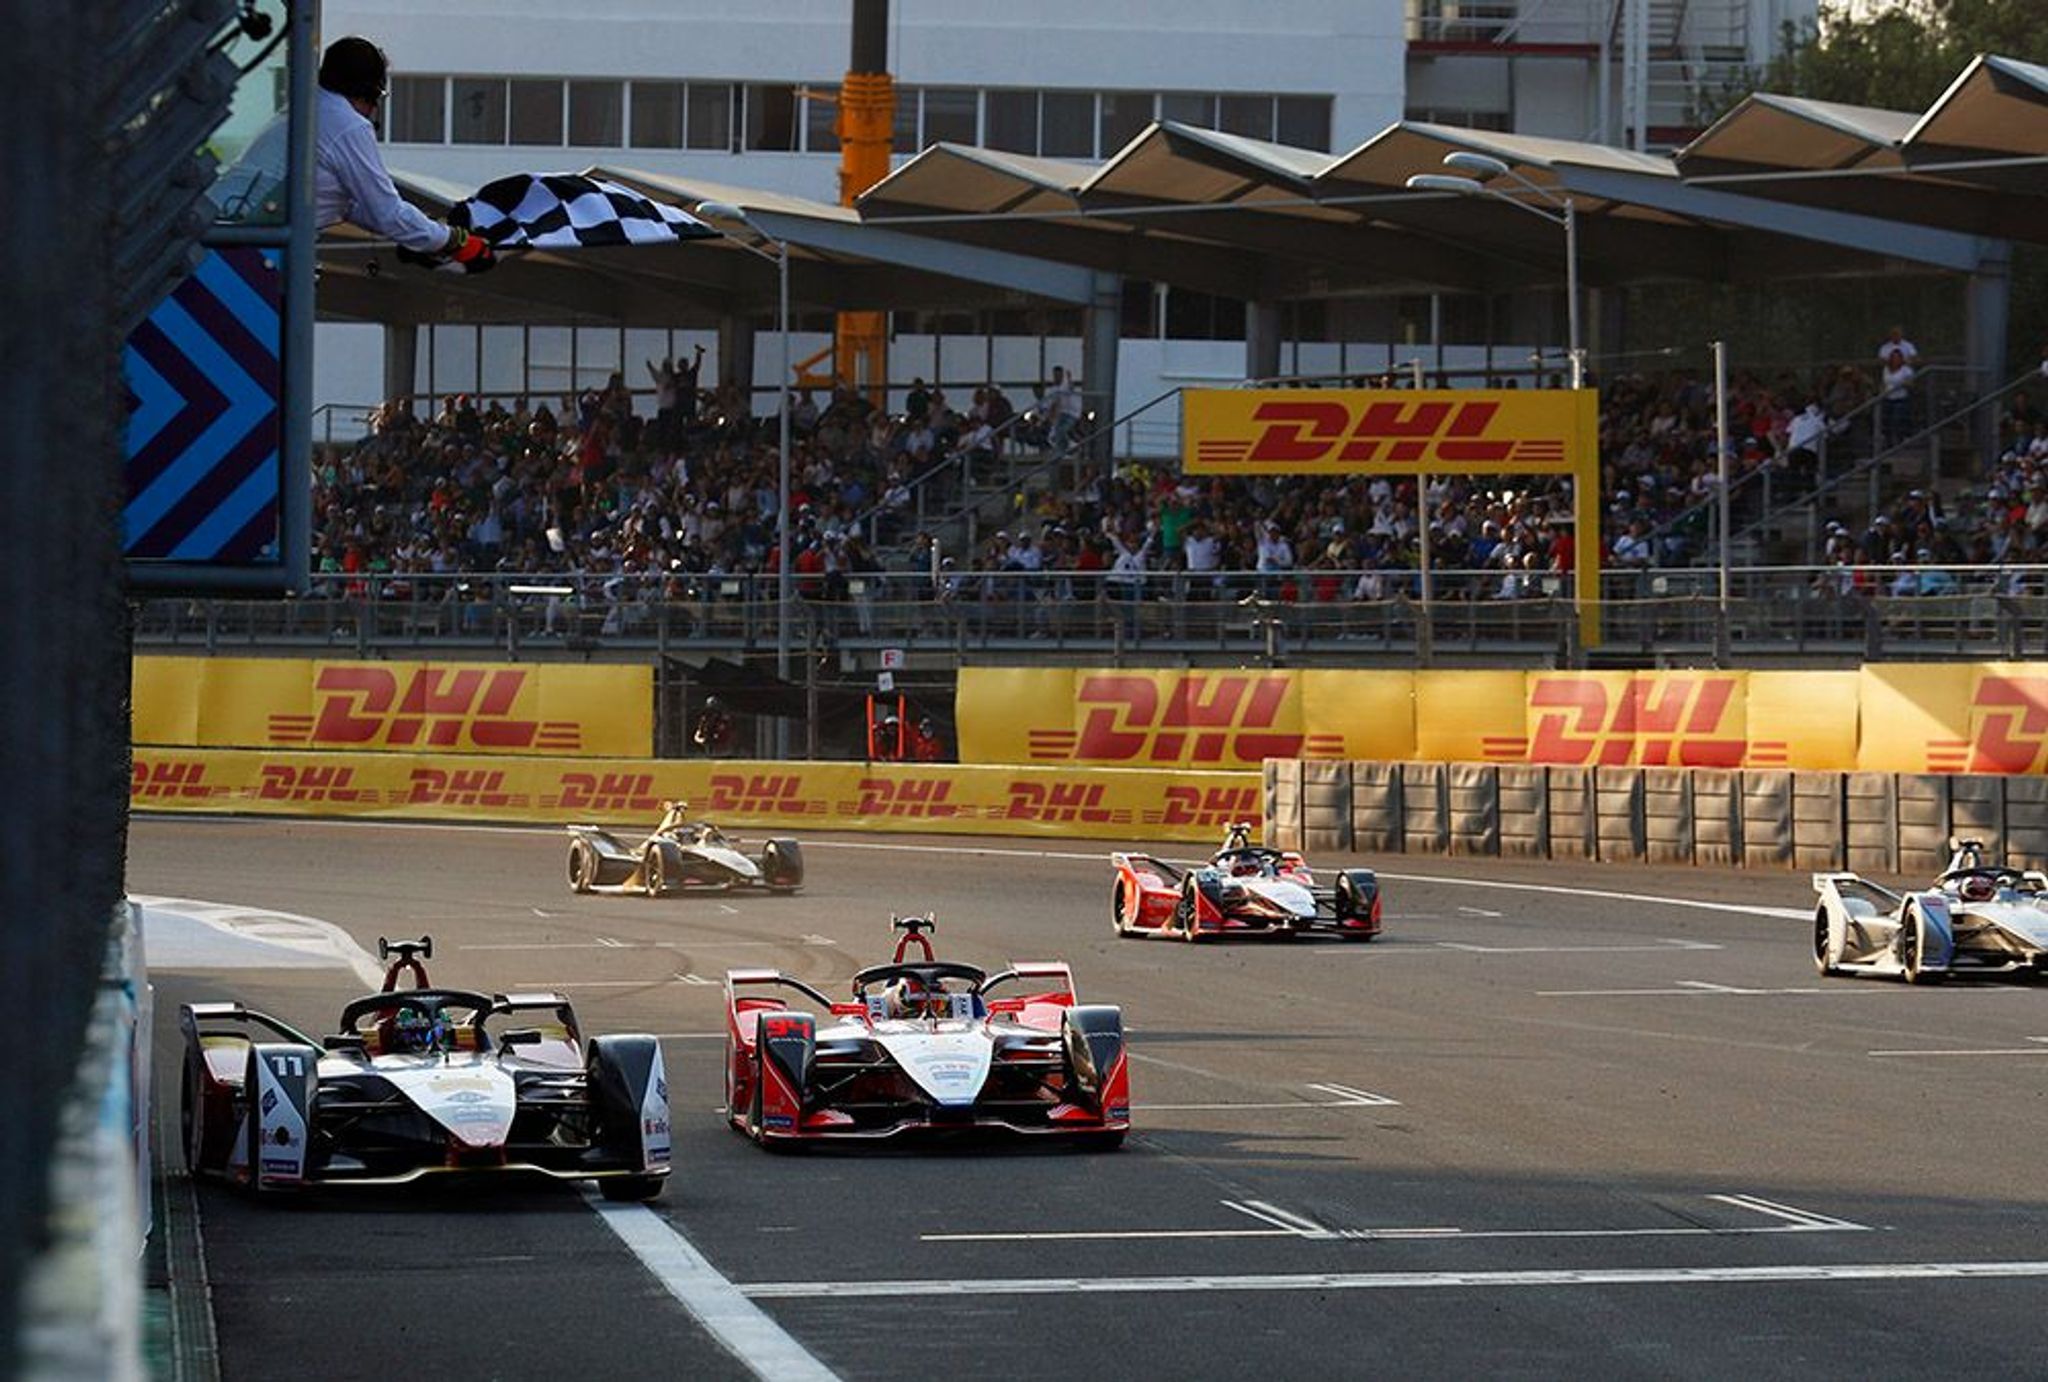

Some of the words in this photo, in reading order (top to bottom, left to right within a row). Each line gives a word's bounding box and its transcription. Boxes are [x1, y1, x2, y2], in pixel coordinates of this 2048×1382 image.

[1247, 402, 1516, 462] DHL
[884, 651, 897, 667] F
[311, 666, 538, 747] DHL
[1073, 676, 1305, 762] DHL
[1529, 678, 1748, 767] DHL
[1969, 676, 2048, 774] D
[259, 764, 360, 802] DHL
[407, 768, 509, 806] DHL
[558, 772, 660, 810] DHL
[708, 775, 806, 814] DHL
[856, 778, 957, 817] DHL
[1006, 782, 1112, 823] DHL
[1163, 786, 1263, 828] DHL
[766, 1018, 812, 1040] 94
[271, 1055, 304, 1077] 11
